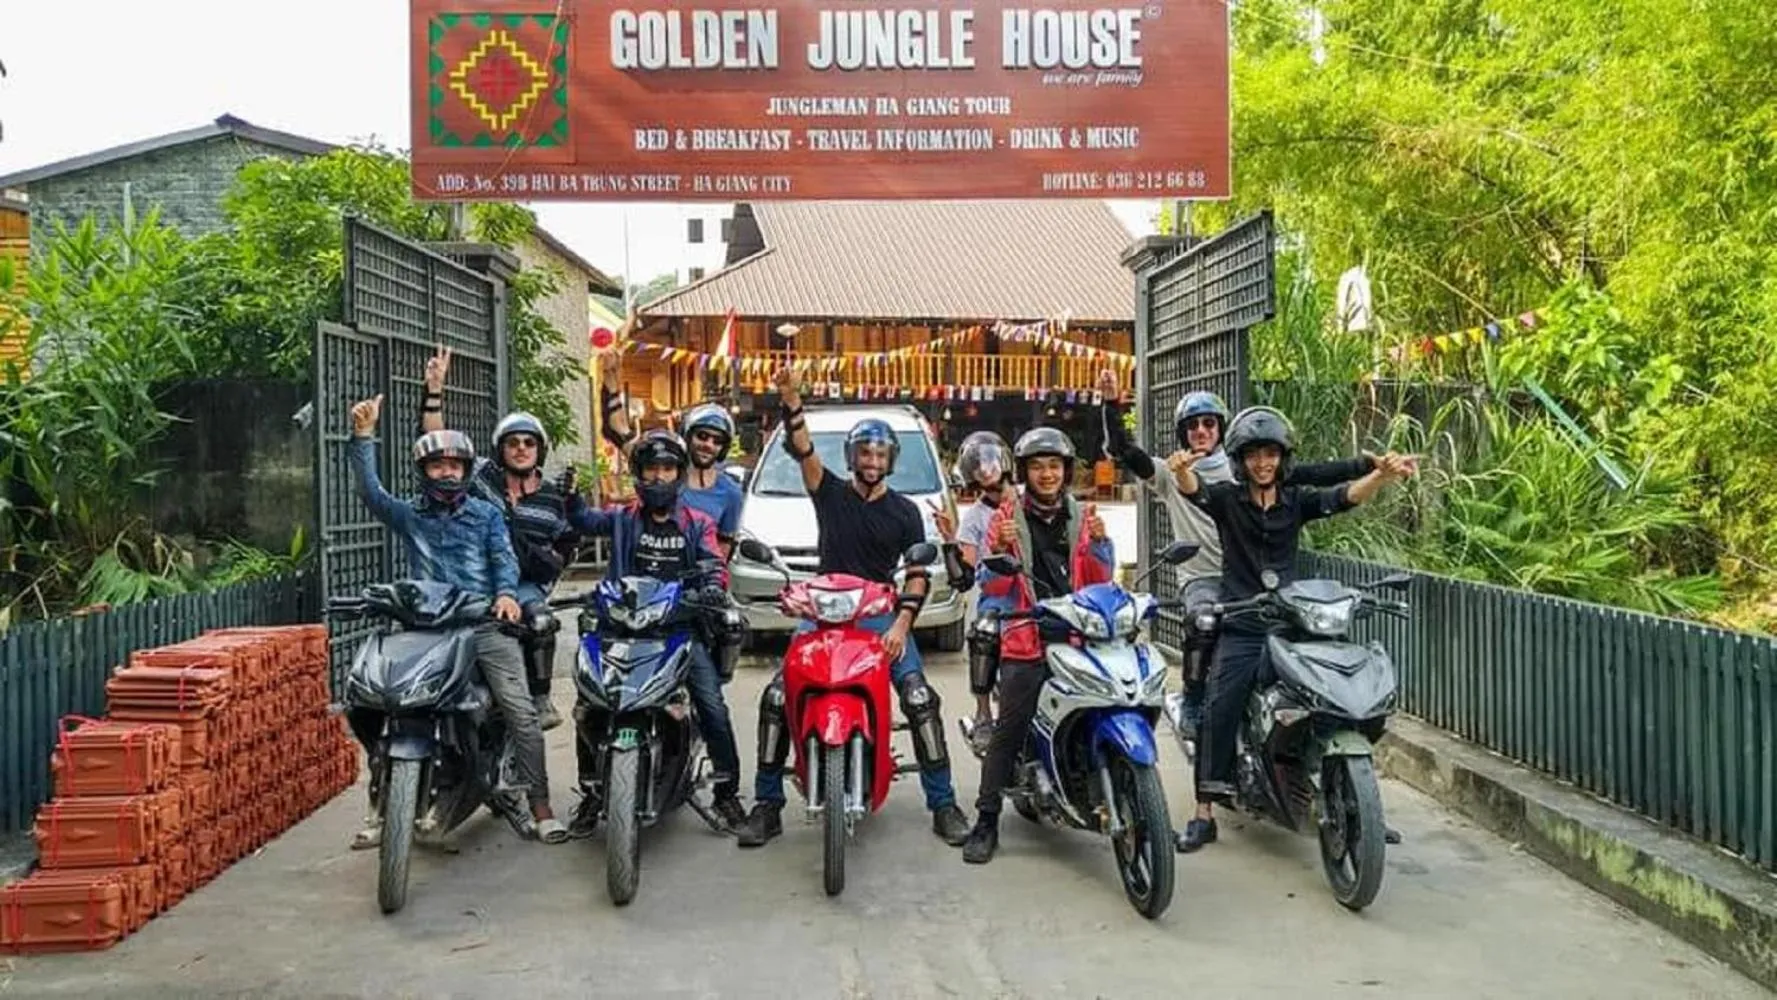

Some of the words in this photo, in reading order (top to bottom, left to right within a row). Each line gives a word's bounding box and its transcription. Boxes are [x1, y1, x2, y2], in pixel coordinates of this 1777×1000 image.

[610, 9, 778, 69] GOLDEN
[807, 9, 975, 69] JUNGLE
[1002, 9, 1142, 69] HOUSE
[1043, 74, 1063, 84] we
[1067, 74, 1091, 85] are
[1095, 71, 1143, 88] family
[766, 97, 868, 115] JUNGLEMAN
[875, 97, 899, 115] HA
[906, 97, 959, 115] GIANG
[965, 97, 1011, 115] TOUR
[635, 129, 669, 151] BED
[675, 131, 688, 149] &
[692, 129, 790, 151] BREAKFAST
[807, 129, 872, 151] TRAVEL
[876, 128, 993, 151] INFORMATION
[1010, 127, 1063, 149] DRINK
[1069, 130, 1081, 149] &
[1087, 127, 1139, 149] MUSIC
[436, 174, 469, 190] ADD:
[474, 175, 495, 190] No.
[531, 174, 555, 191] HAI
[559, 174, 578, 191] BA
[582, 174, 627, 191] TRUNG
[630, 174, 681, 191] STREET
[693, 174, 712, 191] HA
[716, 174, 758, 191] GIANG
[762, 174, 792, 191] CITY
[1042, 173, 1103, 190] HOTLINE:
[1137, 172, 1162, 189] 212
[1167, 172, 1184, 188] 66
